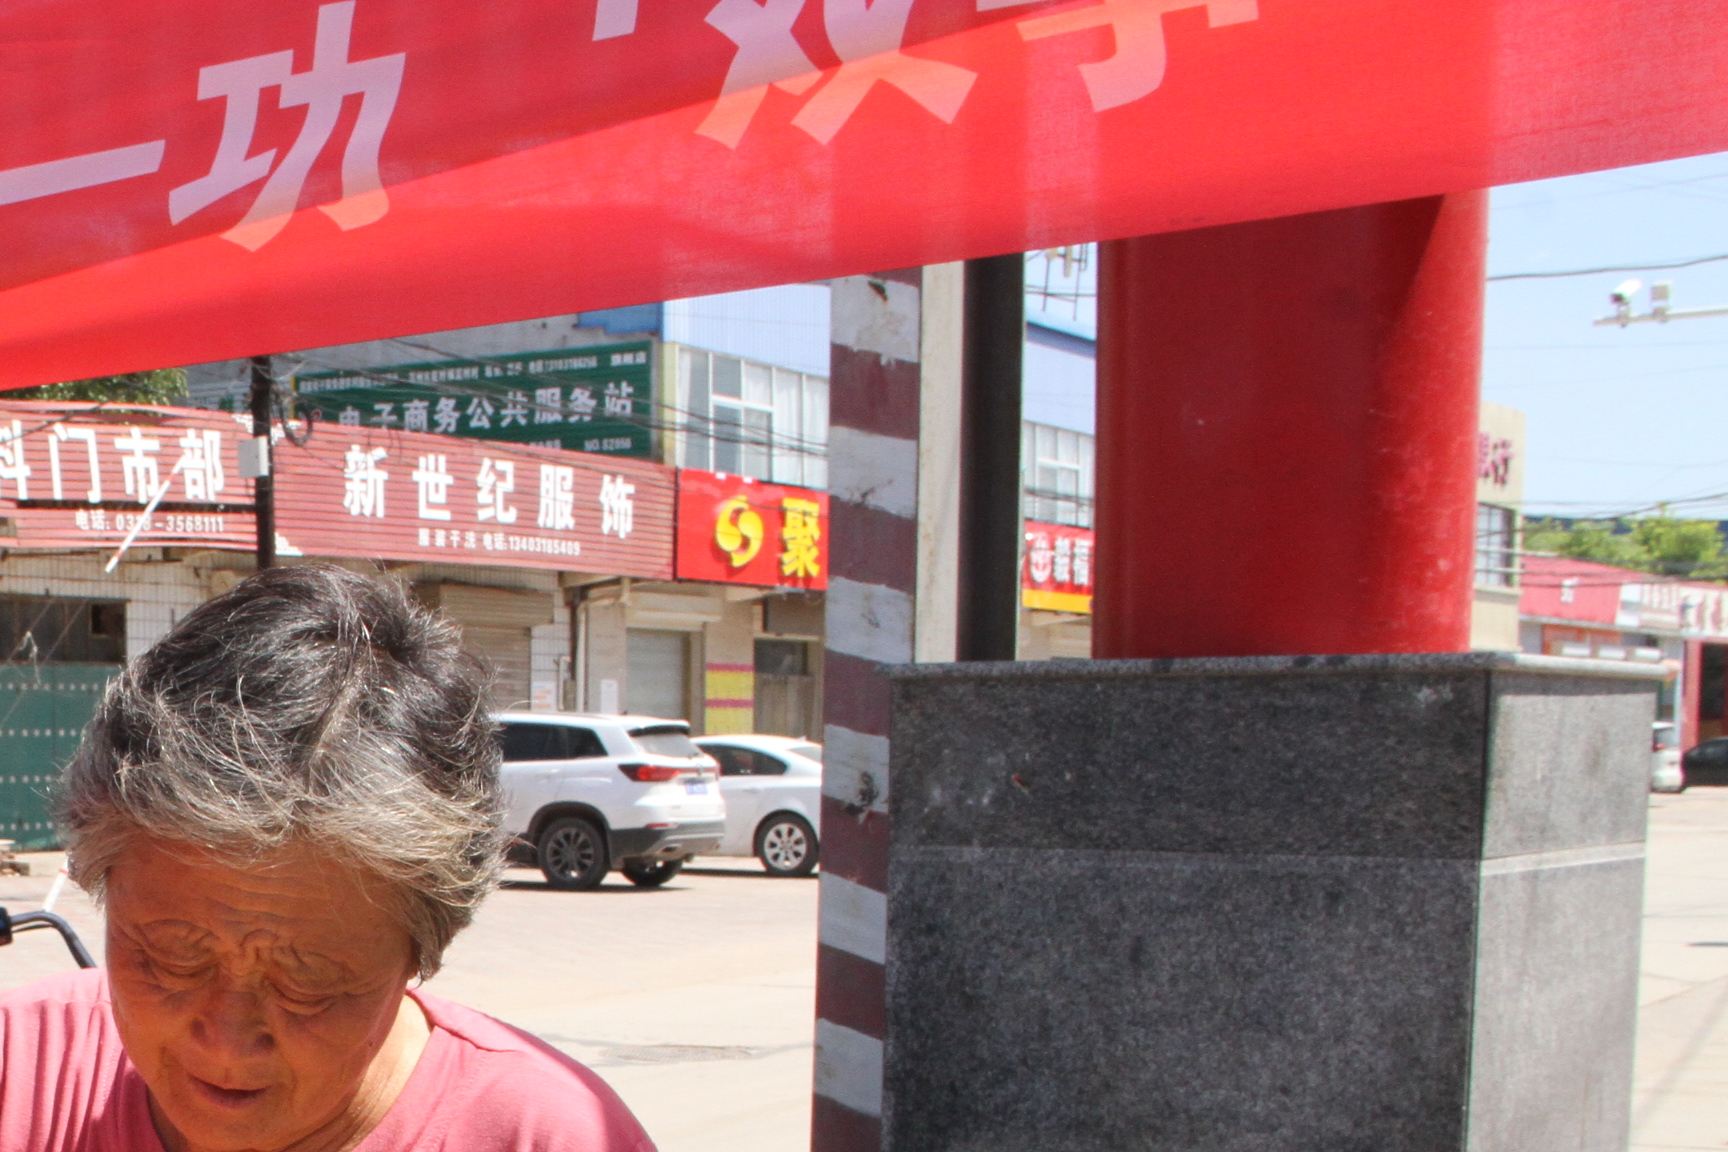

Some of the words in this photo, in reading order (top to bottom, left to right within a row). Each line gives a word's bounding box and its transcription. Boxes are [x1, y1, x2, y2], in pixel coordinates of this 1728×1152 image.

[342, 444, 636, 540] 新世纪服饰
